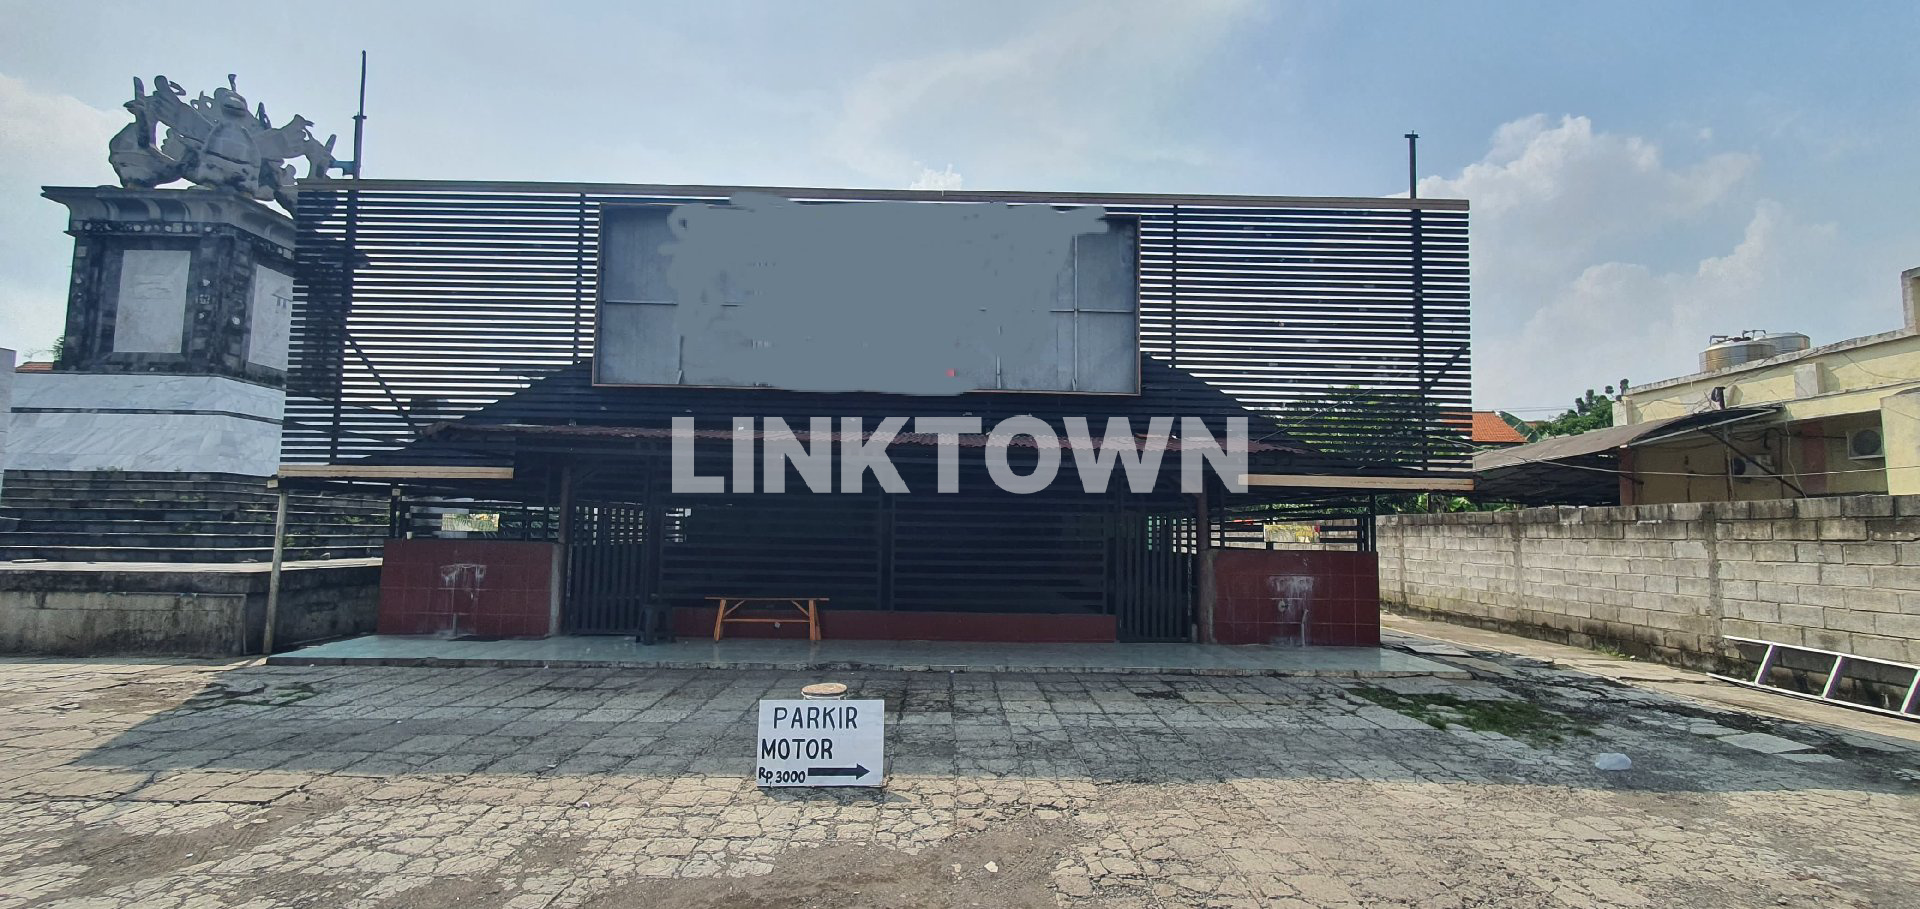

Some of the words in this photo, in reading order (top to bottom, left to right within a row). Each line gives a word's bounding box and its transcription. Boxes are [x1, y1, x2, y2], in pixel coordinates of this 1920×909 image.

[773, 706, 858, 730] PARKIR
[761, 738, 833, 760] MOTOR
[775, 770, 806, 783] 3000
